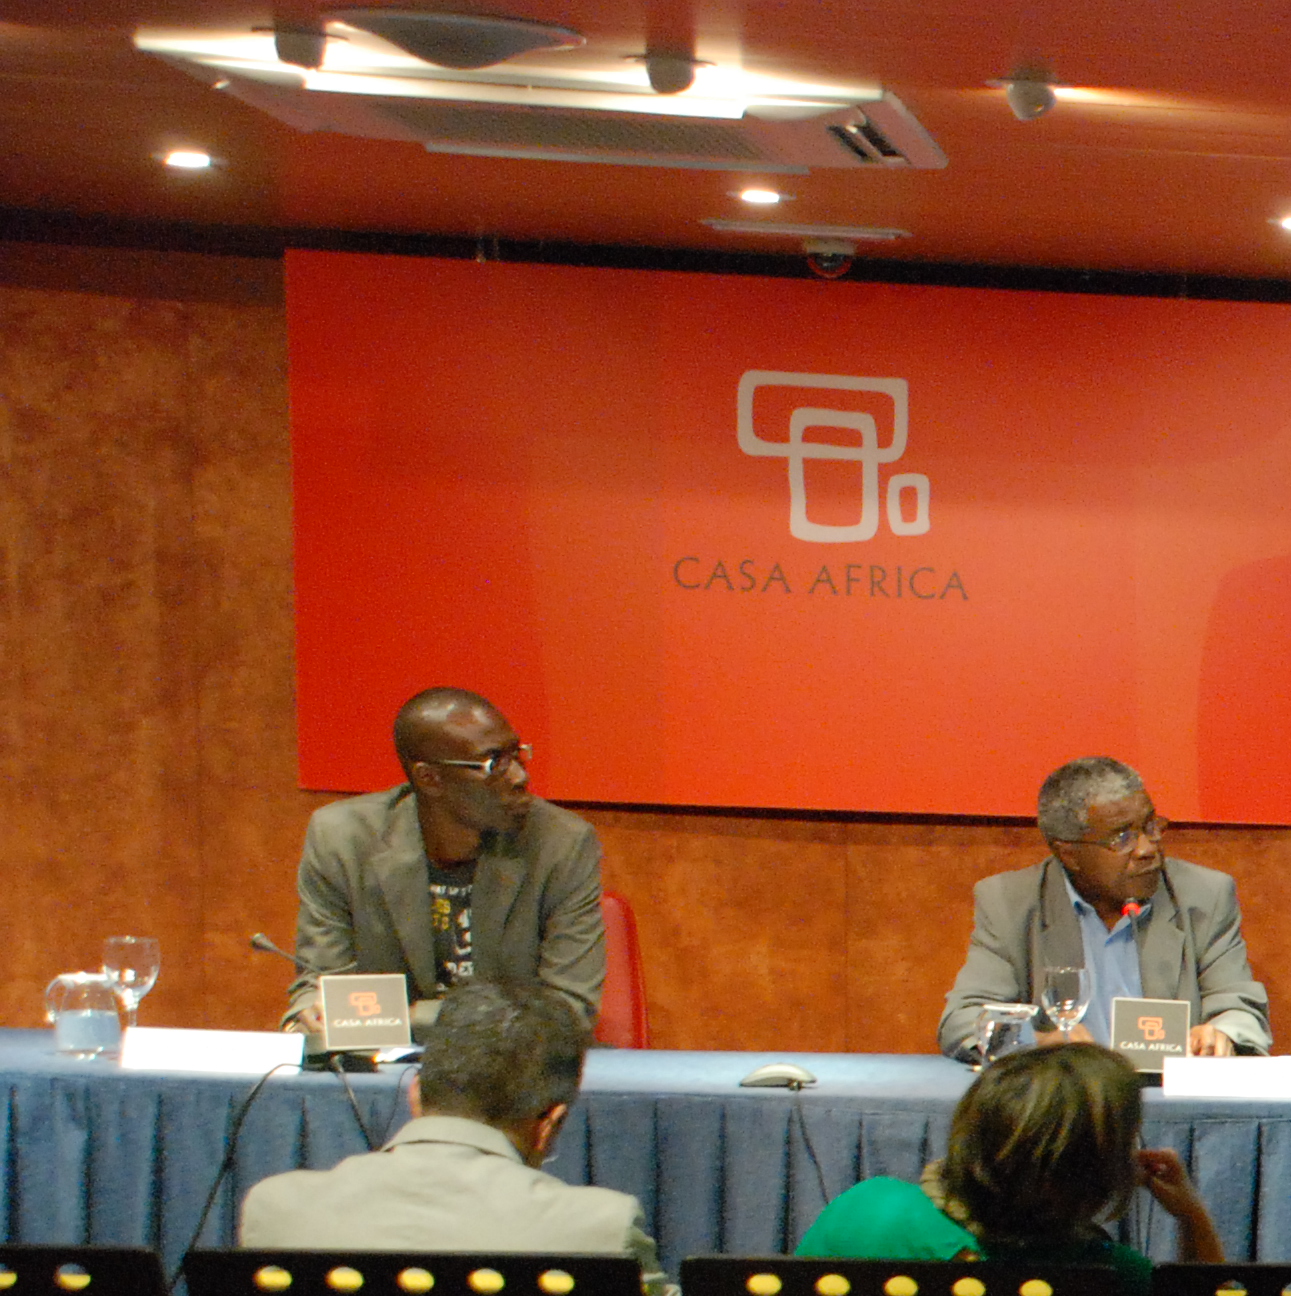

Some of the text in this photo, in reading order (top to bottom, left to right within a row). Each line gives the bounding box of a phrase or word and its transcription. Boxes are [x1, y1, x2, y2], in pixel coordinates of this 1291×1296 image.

[673, 556, 969, 601] CASA AFRICA
[333, 1017, 403, 1028] CASA AFRICA
[1120, 1041, 1183, 1053] CASA AFRICA
